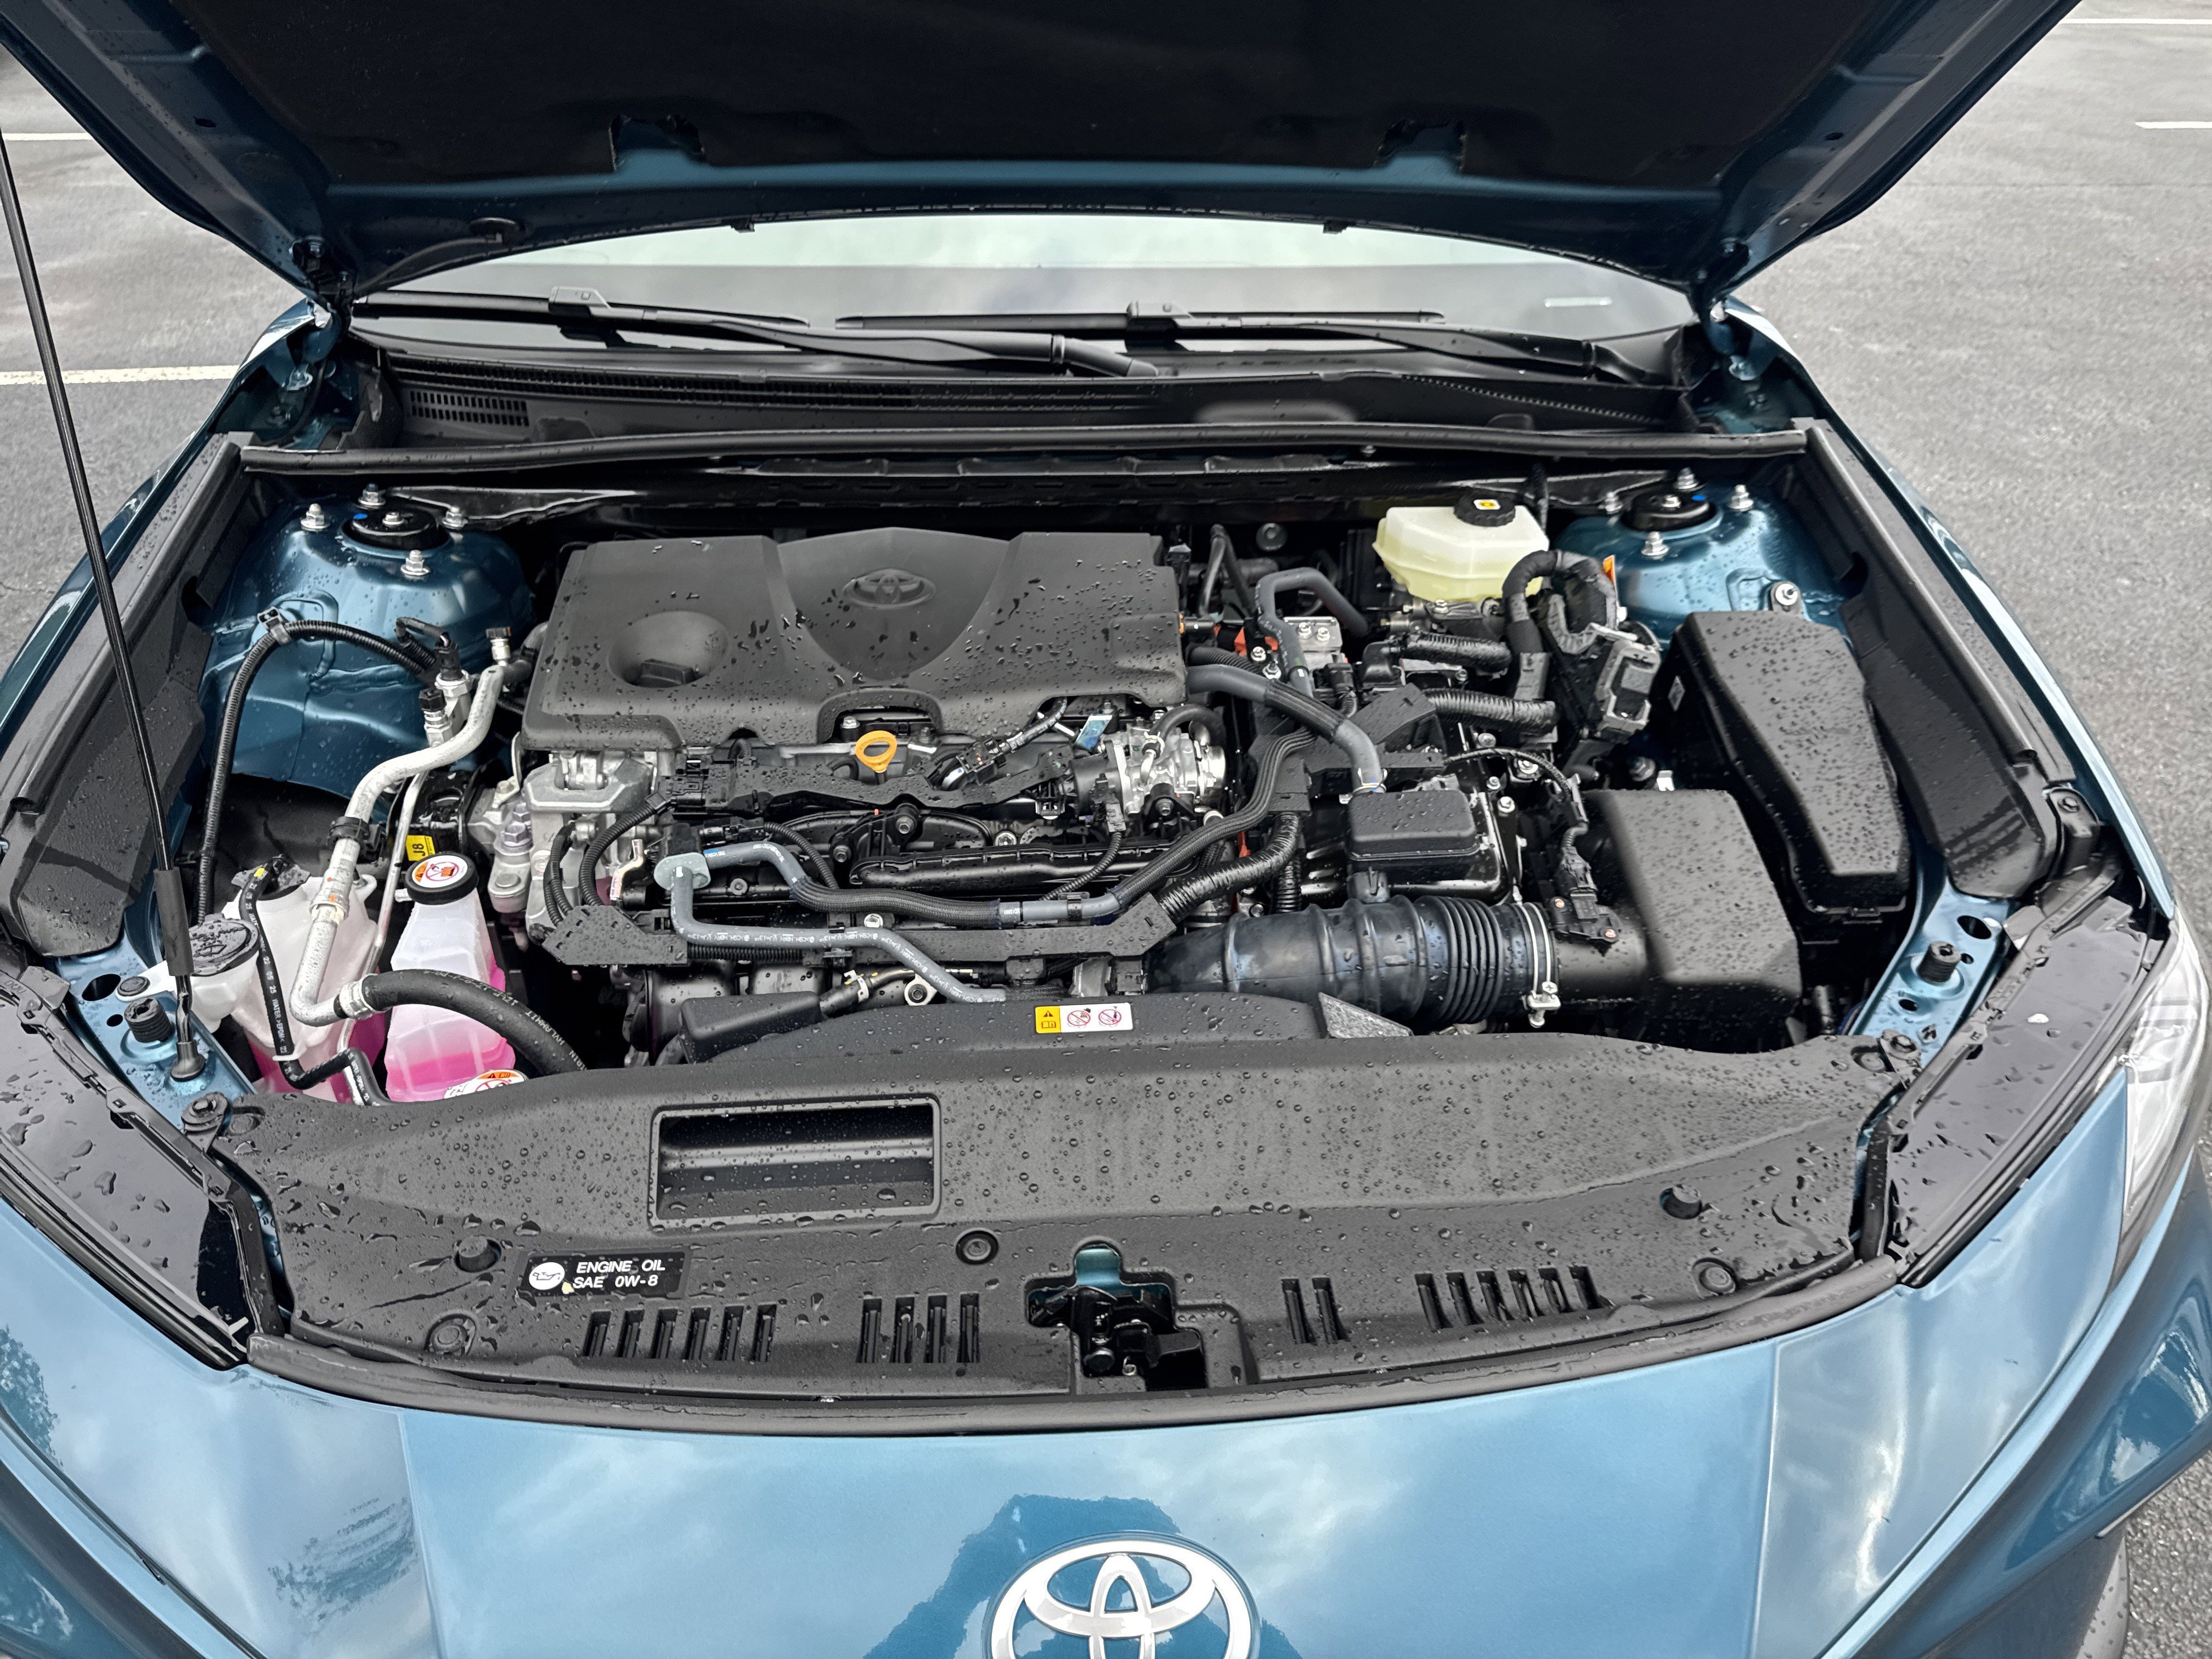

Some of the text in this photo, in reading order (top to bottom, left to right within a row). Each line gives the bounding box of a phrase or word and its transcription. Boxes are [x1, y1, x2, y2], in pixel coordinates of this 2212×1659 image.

[412, 843, 426, 856] J8
[269, 986, 277, 994] 25
[272, 998, 281, 1020] WATER
[576, 1259, 665, 1273] ENGINE OIL
[572, 1275, 658, 1289] SAE 0W-8
